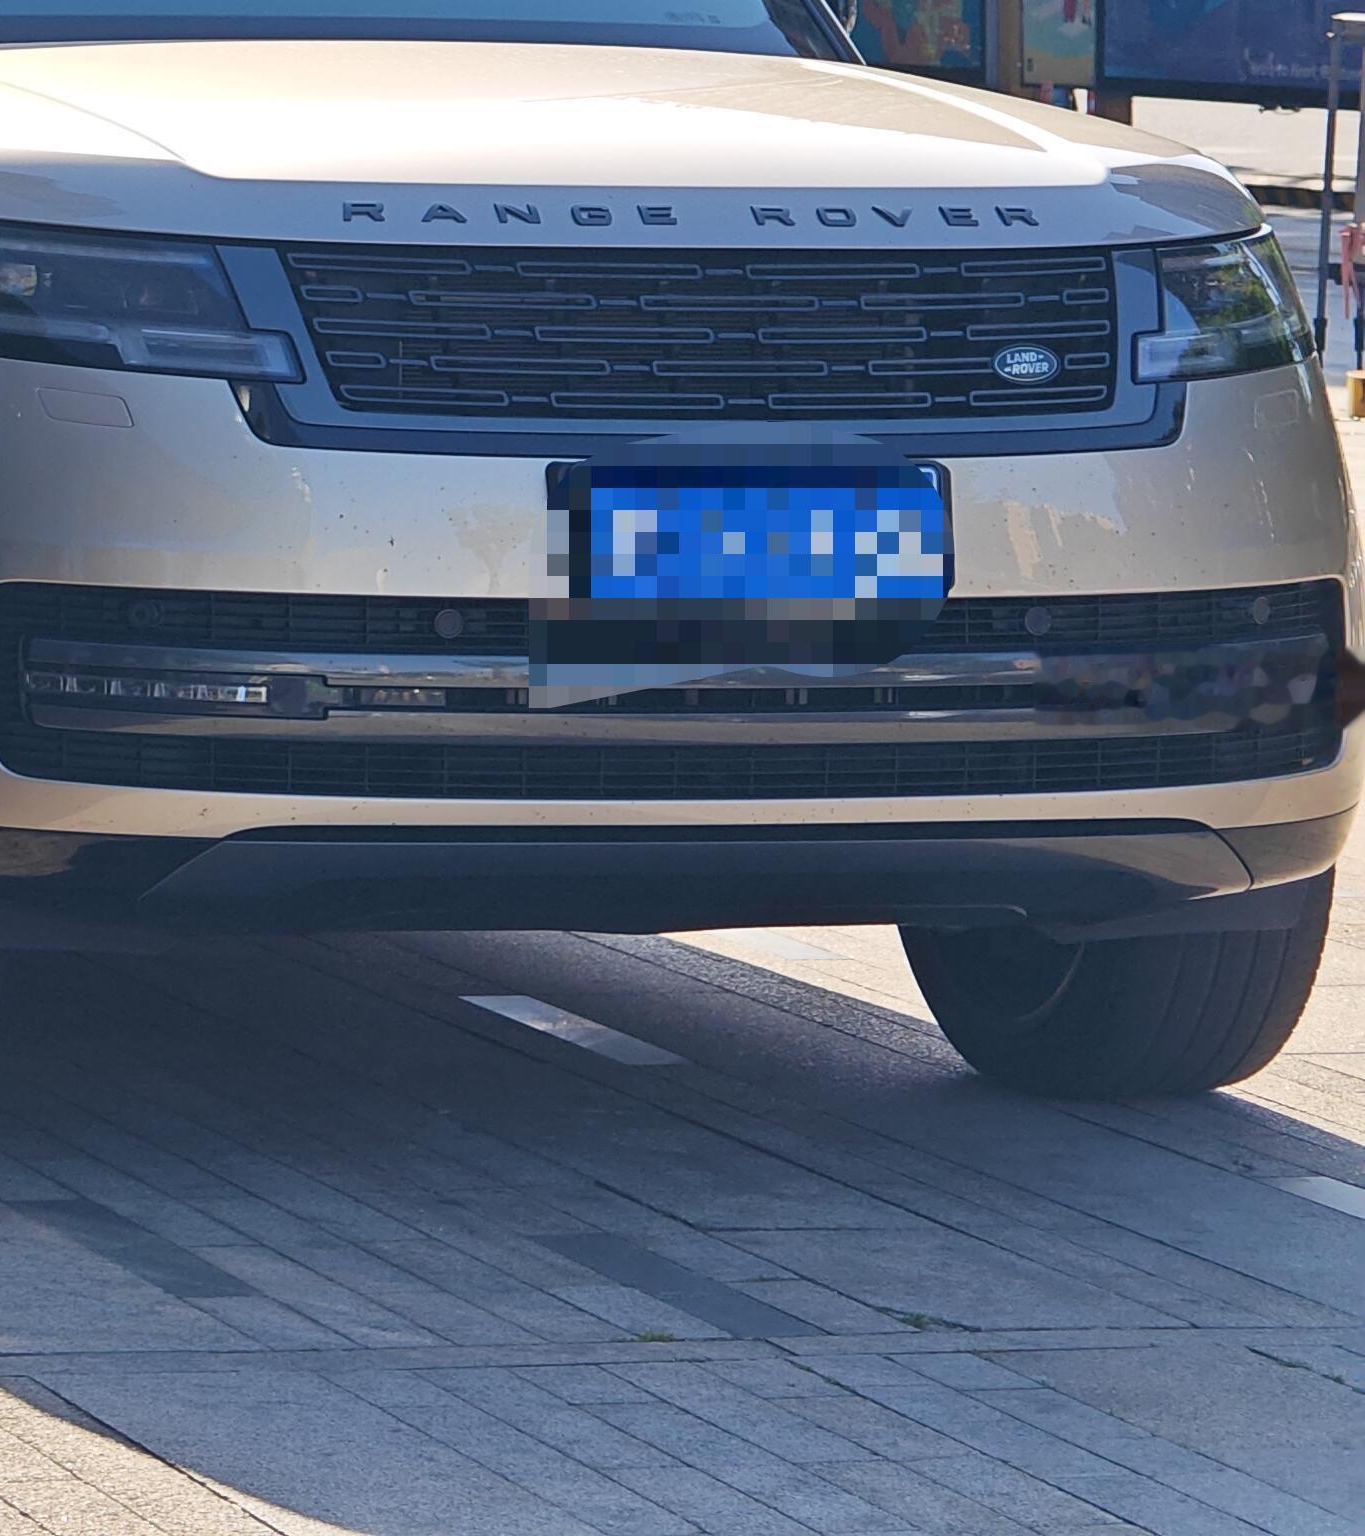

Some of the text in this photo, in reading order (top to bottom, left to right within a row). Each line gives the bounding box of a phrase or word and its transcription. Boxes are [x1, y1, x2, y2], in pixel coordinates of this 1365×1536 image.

[342, 201, 1040, 228] RANGE ROVER
[1006, 351, 1038, 364] LAND
[1011, 362, 1049, 375] ROVER
